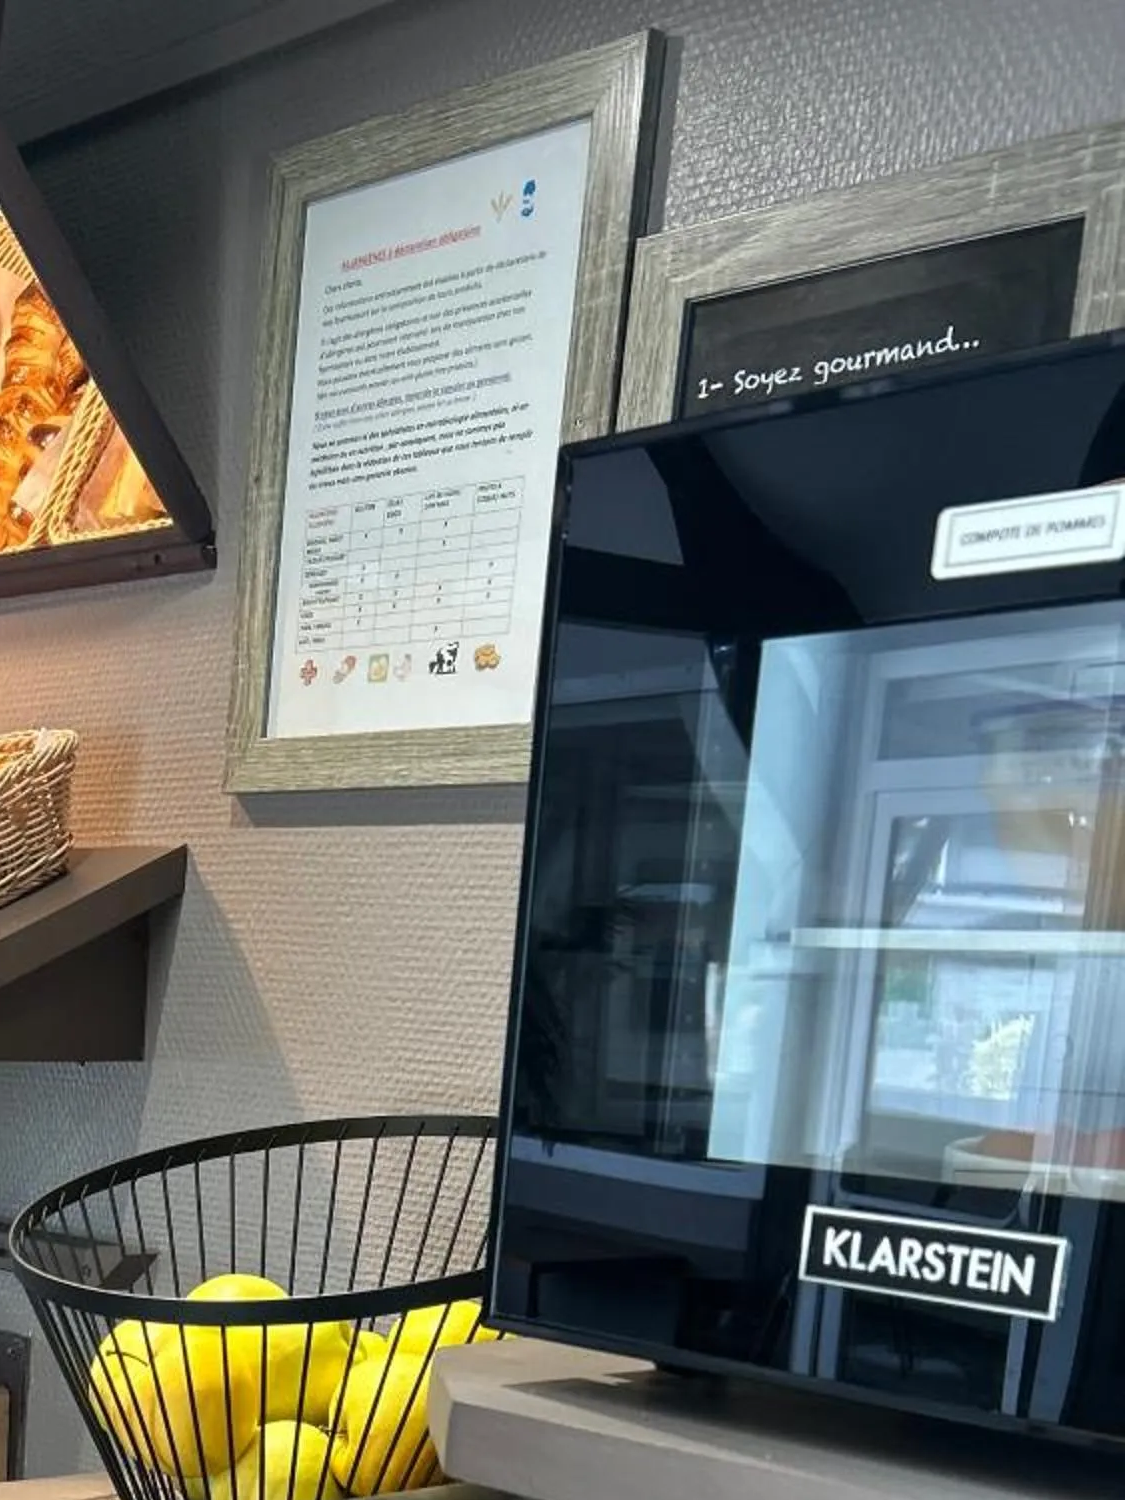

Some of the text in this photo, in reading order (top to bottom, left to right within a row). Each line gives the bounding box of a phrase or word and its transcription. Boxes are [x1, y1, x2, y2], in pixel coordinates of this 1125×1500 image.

[732, 364, 804, 396] Soyez
[813, 324, 981, 386] gourmand...
[822, 1225, 1036, 1297] KLARSTEIN
